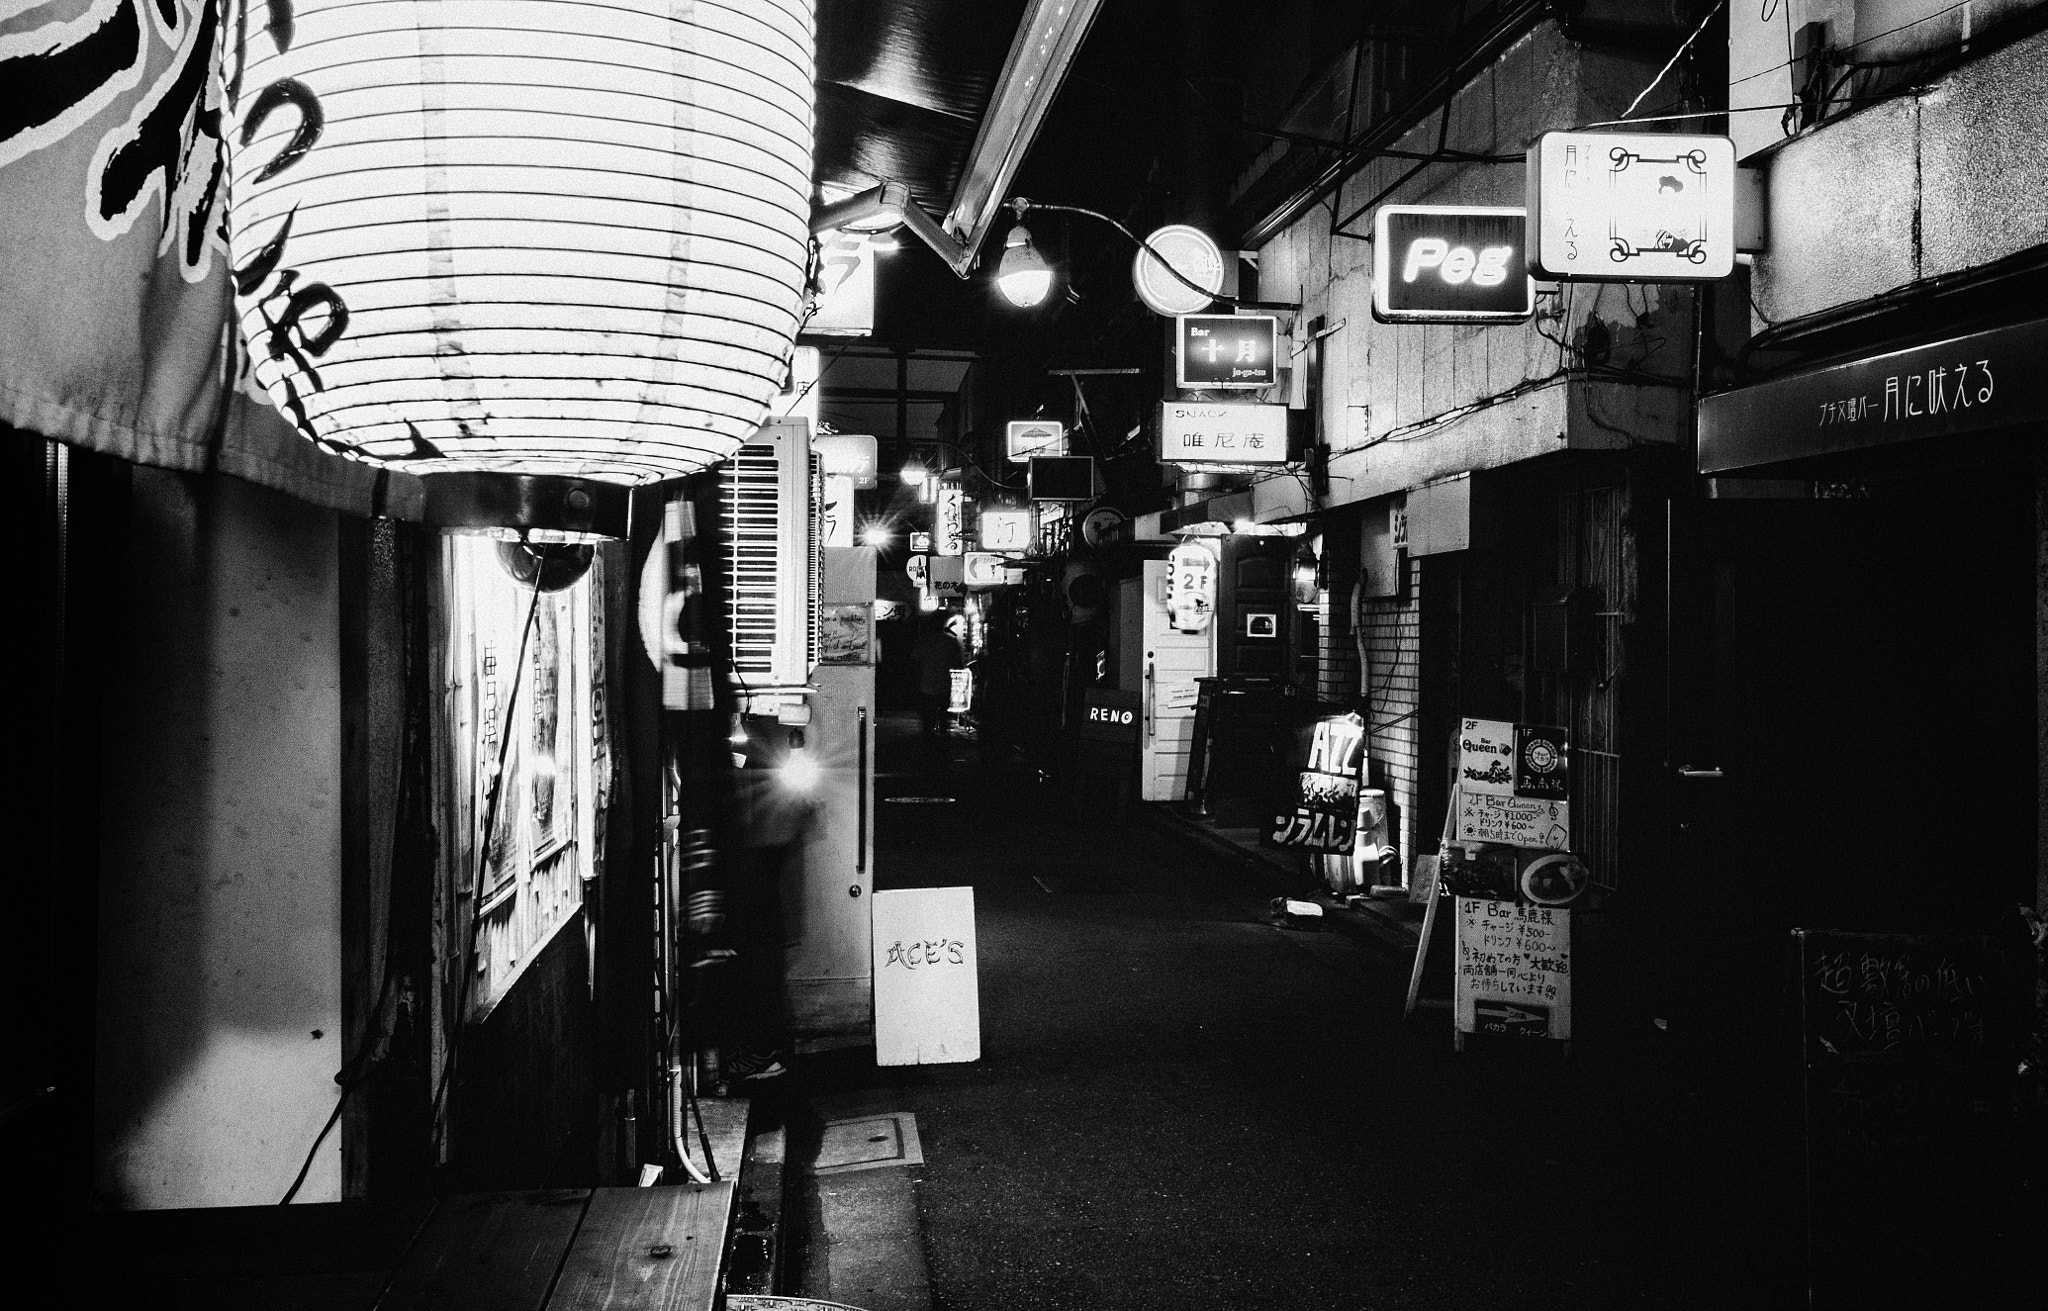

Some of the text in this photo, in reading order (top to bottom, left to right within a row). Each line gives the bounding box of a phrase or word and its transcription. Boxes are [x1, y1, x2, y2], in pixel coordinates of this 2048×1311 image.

[1402, 237, 1513, 286] Peg
[1190, 327, 1211, 337] Bar
[1202, 338, 1257, 363] 十月
[1818, 358, 1995, 427] プチ文壇バー 月に吠える
[1175, 409, 1227, 420] SNACK
[1182, 432, 1266, 450] 唯尼庵
[858, 476, 871, 485] 2F
[1183, 572, 1208, 590] 2F
[1089, 707, 1133, 724] RENO
[1465, 720, 1478, 730] 2F
[1521, 728, 1534, 737] 1F
[1462, 739, 1497, 754] Queen
[1486, 795, 1506, 806] Bar
[1507, 796, 1536, 810] Queen
[1480, 818, 1503, 828] ドリンク
[1464, 901, 1481, 914] 1F
[1487, 903, 1512, 919] Bar
[1481, 919, 1514, 933] チャージ
[1483, 934, 1512, 948] ドリンク
[884, 938, 965, 971] ACE'S
